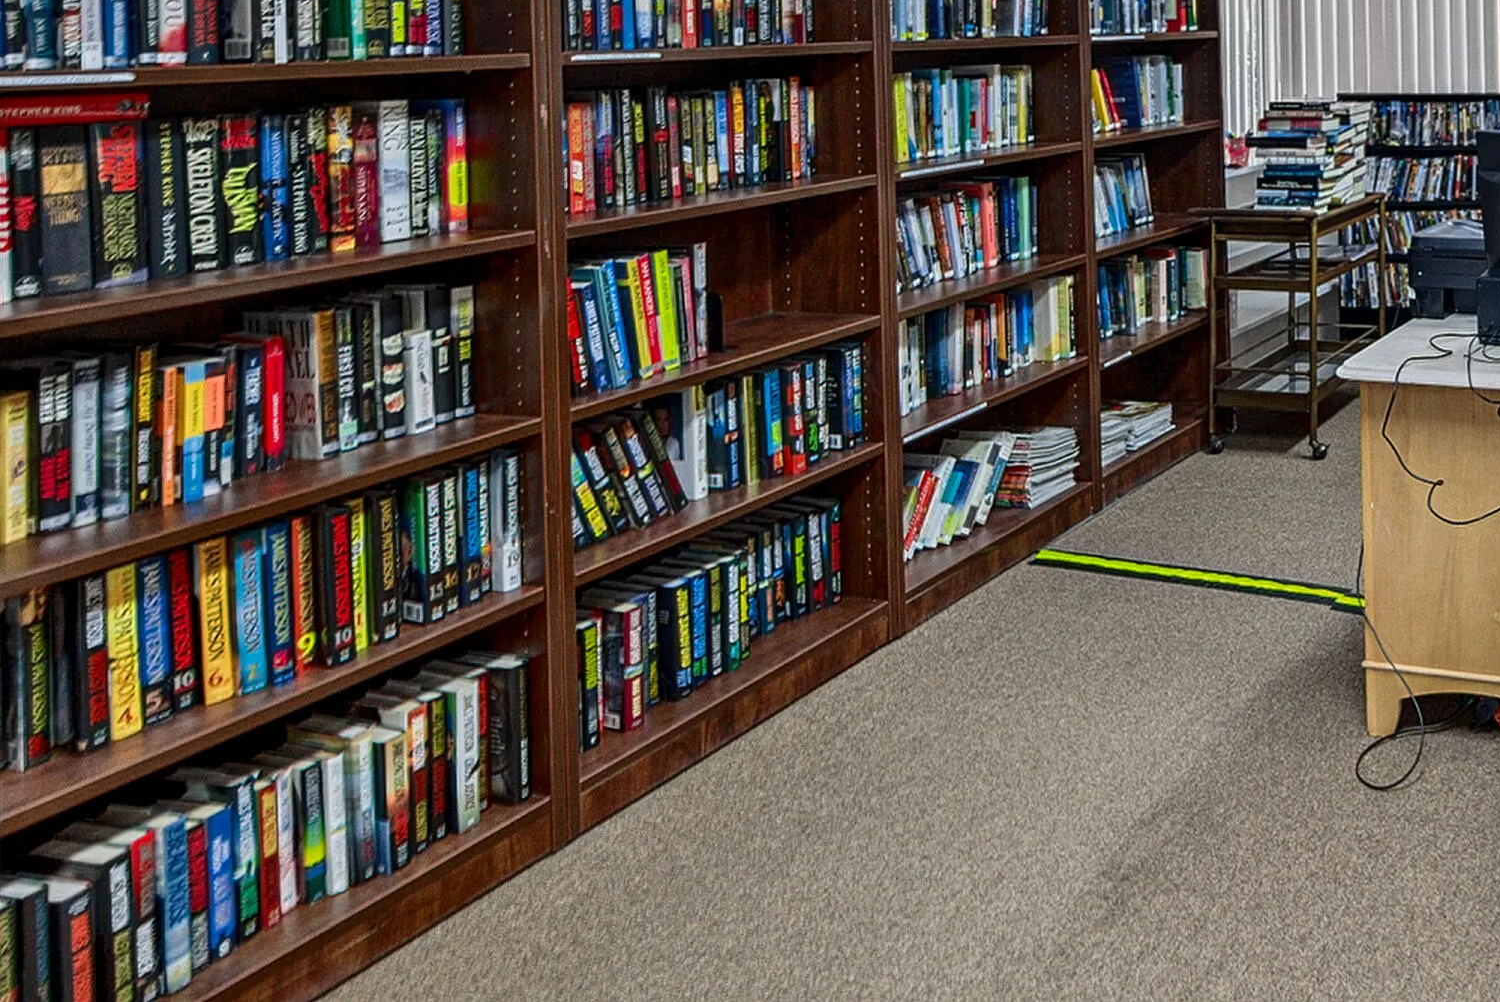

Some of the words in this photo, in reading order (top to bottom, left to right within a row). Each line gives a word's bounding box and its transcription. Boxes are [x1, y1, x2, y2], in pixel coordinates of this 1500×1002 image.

[451, 3, 460, 43] HOLLY
[111, 125, 138, 192] STEPHEN
[159, 122, 173, 174] STEPHEN
[162, 177, 175, 207] KING
[187, 147, 214, 214] SKELETON
[221, 161, 258, 234] TALISMAN
[291, 169, 307, 221] STEPHEN
[190, 215, 217, 255] CREW
[292, 223, 308, 254] KING
[641, 262, 650, 278] IAN
[644, 280, 654, 316] RANKIN
[338, 345, 354, 376] FIRST
[339, 378, 354, 398] CUT
[466, 468, 478, 501] JAMES
[504, 456, 518, 485] JAMES
[426, 483, 439, 516] JAMES
[443, 476, 456, 509] JAMES
[506, 486, 519, 535] PATTERSON
[332, 513, 348, 548] JAMES
[379, 498, 393, 531] JAMES
[466, 502, 479, 557] PATTERSON
[271, 532, 288, 571] JAMES
[427, 517, 441, 574] PATTERSON
[444, 509, 457, 566] PATTERSON
[203, 542, 223, 586] JAMES
[381, 532, 395, 590] PATTERSON
[114, 571, 134, 619] JAMES
[140, 562, 163, 607] JAMES
[333, 548, 351, 627] PATTERSON
[677, 588, 688, 616] JOHN
[693, 578, 706, 605] JOHN
[204, 587, 227, 662] PATTERSON
[243, 583, 263, 654] PATTERSON
[274, 572, 290, 646] PATTERSON
[381, 598, 397, 618] 12
[30, 623, 48, 662] JAMES
[143, 607, 166, 685] PATTERSON
[171, 594, 194, 672] PATTERSON
[297, 630, 317, 658] 9
[334, 628, 352, 648] 10
[679, 616, 691, 667] SANDFORD
[693, 606, 707, 659] SANDFORD
[113, 620, 138, 707] PATTERSON
[172, 668, 195, 691] 10
[208, 669, 224, 688] 6
[31, 663, 48, 735] PATTERSON
[117, 707, 134, 725] 4
